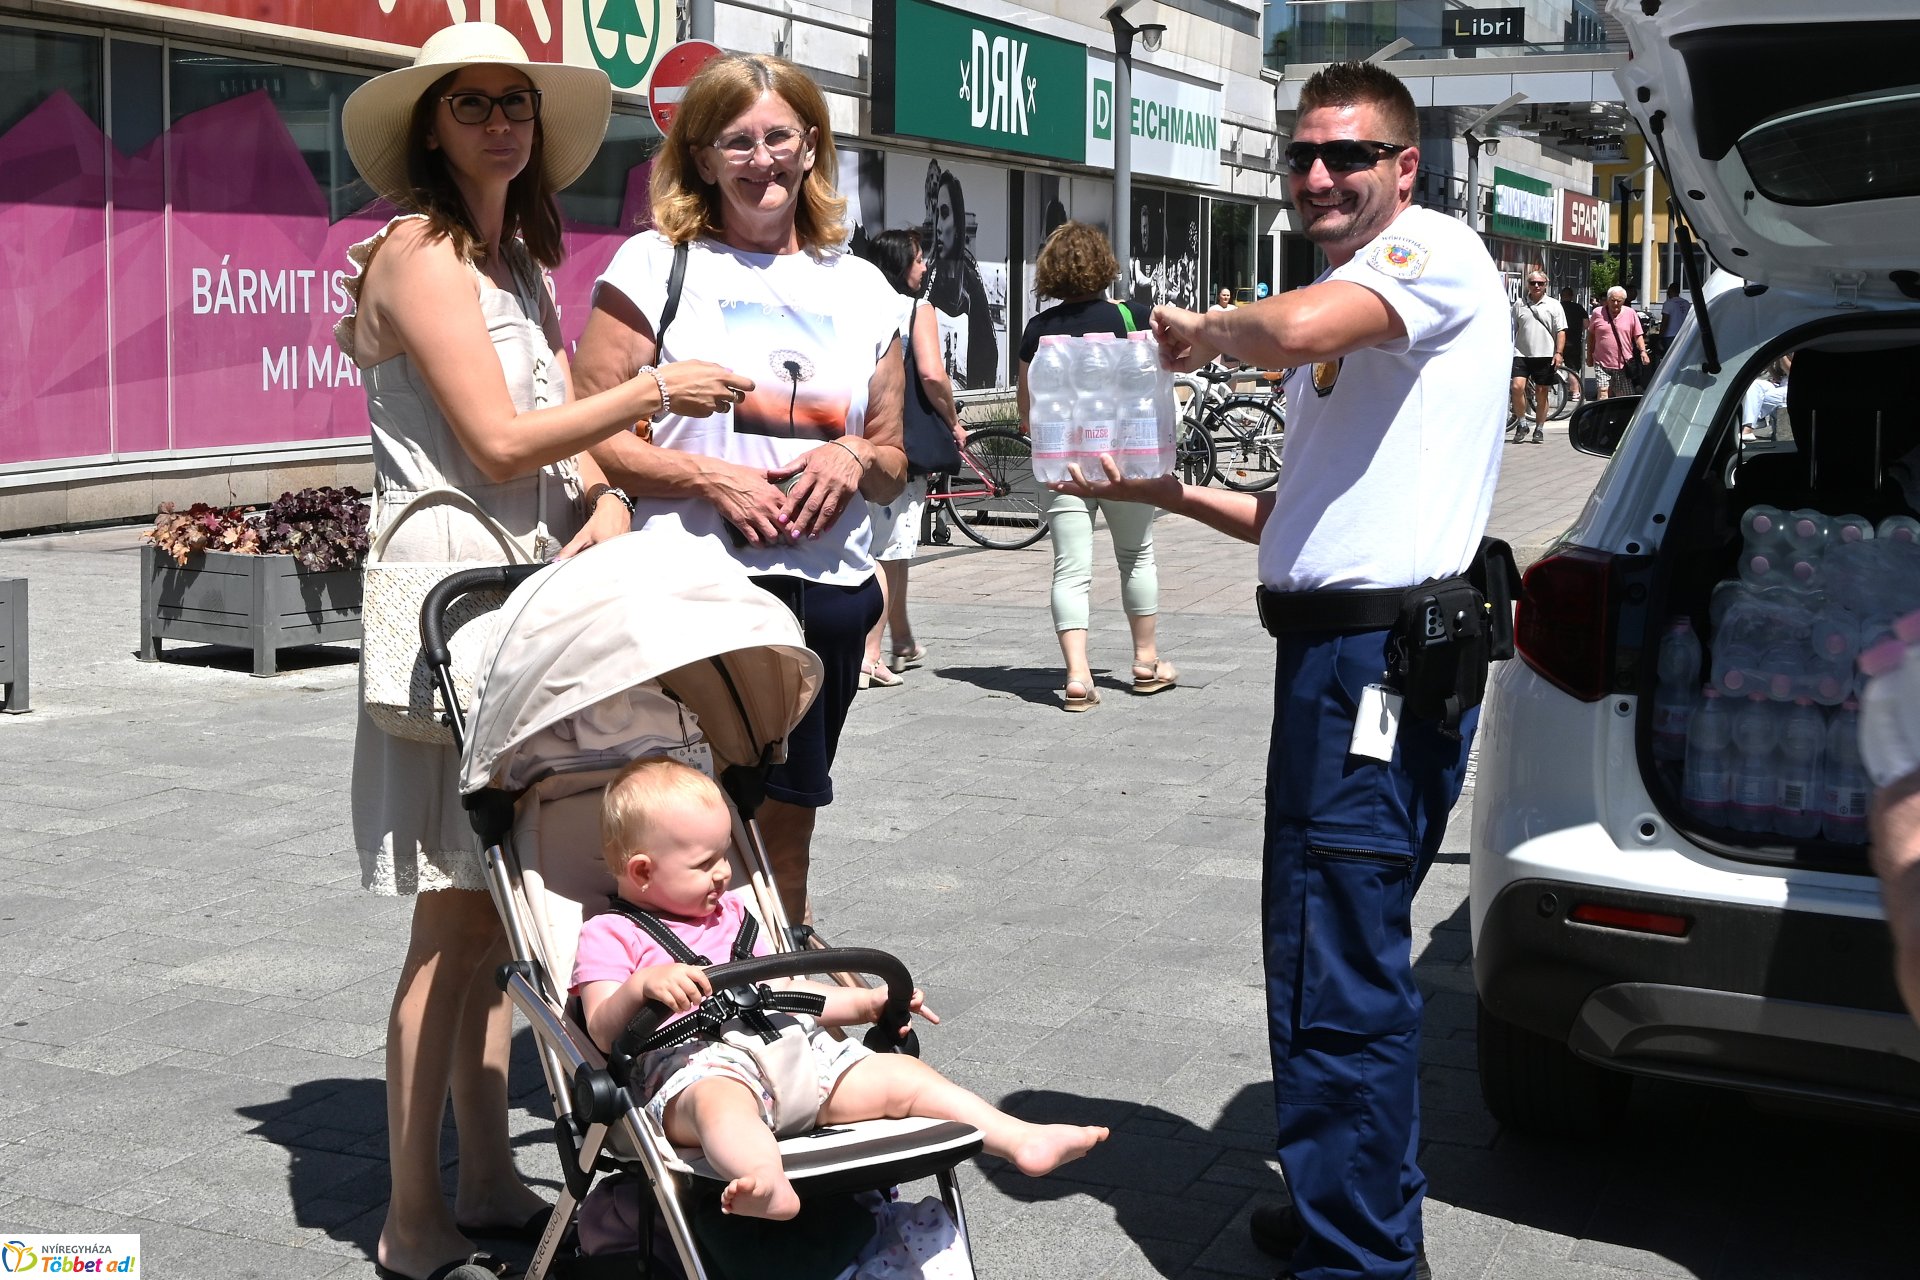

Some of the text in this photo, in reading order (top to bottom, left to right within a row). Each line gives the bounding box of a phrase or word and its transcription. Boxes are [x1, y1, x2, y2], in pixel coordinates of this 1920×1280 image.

[1455, 18, 1511, 36] Libri
[1131, 97, 1217, 151] EICHMANN
[1571, 201, 1598, 239] SPAR
[192, 254, 348, 315] BÁRMIT IS
[262, 345, 298, 391] MI
[1085, 427, 1109, 439] mizse
